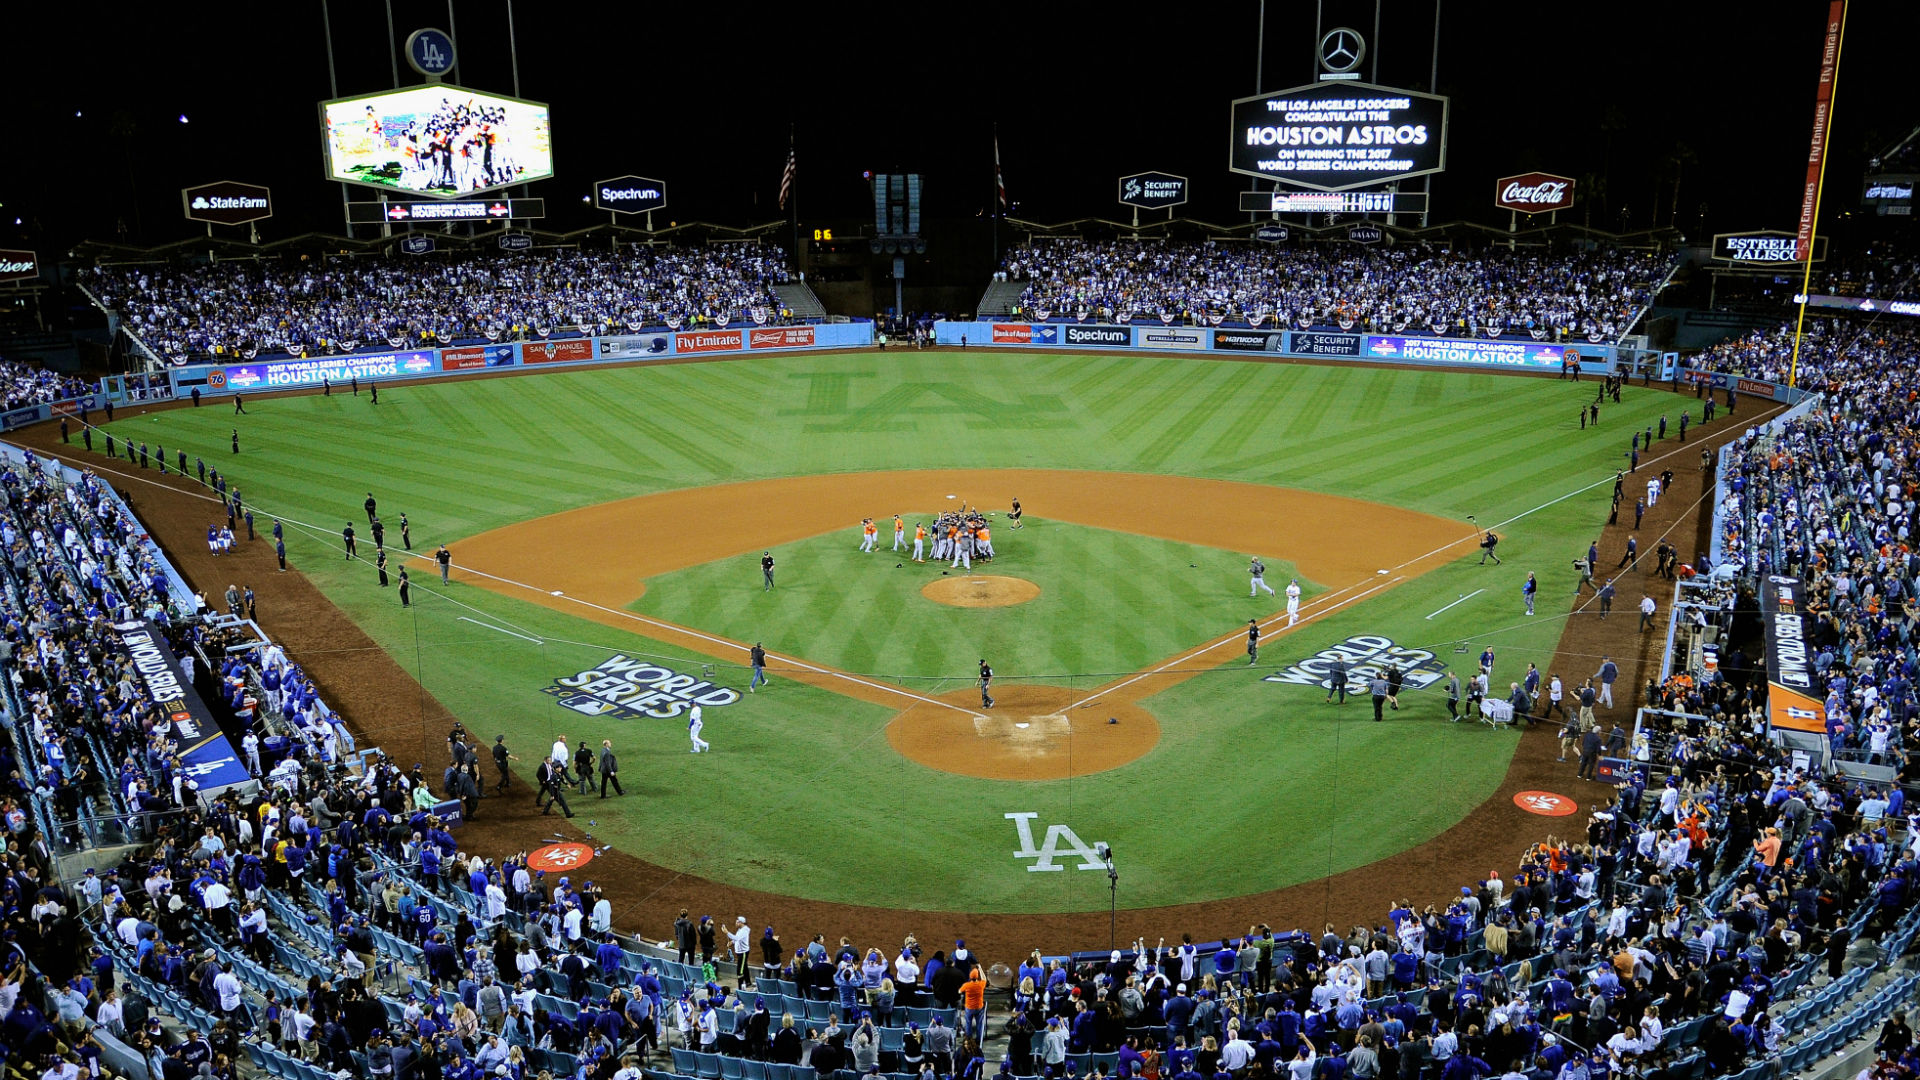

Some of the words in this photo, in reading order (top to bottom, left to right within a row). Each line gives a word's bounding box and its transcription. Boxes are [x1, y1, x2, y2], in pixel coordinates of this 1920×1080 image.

[421, 36, 444, 68] LA
[1267, 101, 1287, 111] THE
[1288, 101, 1308, 110] LOS
[1309, 100, 1356, 110] ANGELES
[1357, 99, 1410, 109] DODGERS
[1285, 112, 1366, 122] CONGRATULATE
[1368, 111, 1389, 121] THE
[1247, 126, 1343, 145] HOUSTON
[1346, 125, 1428, 144] ASTROS
[1278, 150, 1295, 159] ON
[1296, 150, 1344, 159] WINNING
[1345, 149, 1367, 159] THE
[1368, 149, 1392, 159] 2017
[1258, 161, 1295, 171] WORLD
[1297, 161, 1330, 170] SERIES
[1331, 160, 1413, 170] CHAMPIONSHIP
[1145, 181, 1182, 190] SECURITY
[602, 188, 656, 202] Spectrum
[1144, 190, 1176, 198] BENEFIT
[1800, 182, 1815, 224] Emirates
[411, 209, 454, 218] HOUSTON
[455, 208, 486, 217] ASTROS
[1351, 231, 1379, 239] DASANI
[677, 337, 695, 349] Fly
[696, 335, 741, 347] Emirates
[1069, 329, 1124, 342] Spectrum
[1314, 335, 1355, 345] SECURITY
[556, 342, 585, 351] MANUEL
[1313, 345, 1349, 354] BENEFIT
[1404, 339, 1421, 348] 2017
[1422, 340, 1450, 349] WORLD
[1450, 341, 1477, 350] SERIES
[1478, 342, 1525, 353] CHAMPIONS
[1403, 349, 1471, 361] HOUSTON
[1474, 352, 1525, 364] ASTROS
[1566, 353, 1577, 362] 76
[267, 363, 285, 373] 2017
[286, 361, 318, 371] WORLD
[319, 359, 347, 369] SERIES
[348, 355, 396, 367] CHAMPIONS
[210, 374, 224, 385] 76
[267, 369, 342, 385] HOUSTON
[342, 363, 397, 379] ASTROS
[1739, 380, 1750, 391] Fly
[1750, 384, 1773, 395] Emirates
[128, 640, 169, 674] WORLD
[1777, 638, 1808, 671] WORLD
[143, 670, 187, 703] SERIES
[595, 654, 741, 706] WORLD
[558, 670, 694, 719] SERIES
[1004, 811, 1110, 872] LA
[419, 913, 431, 923] 60
